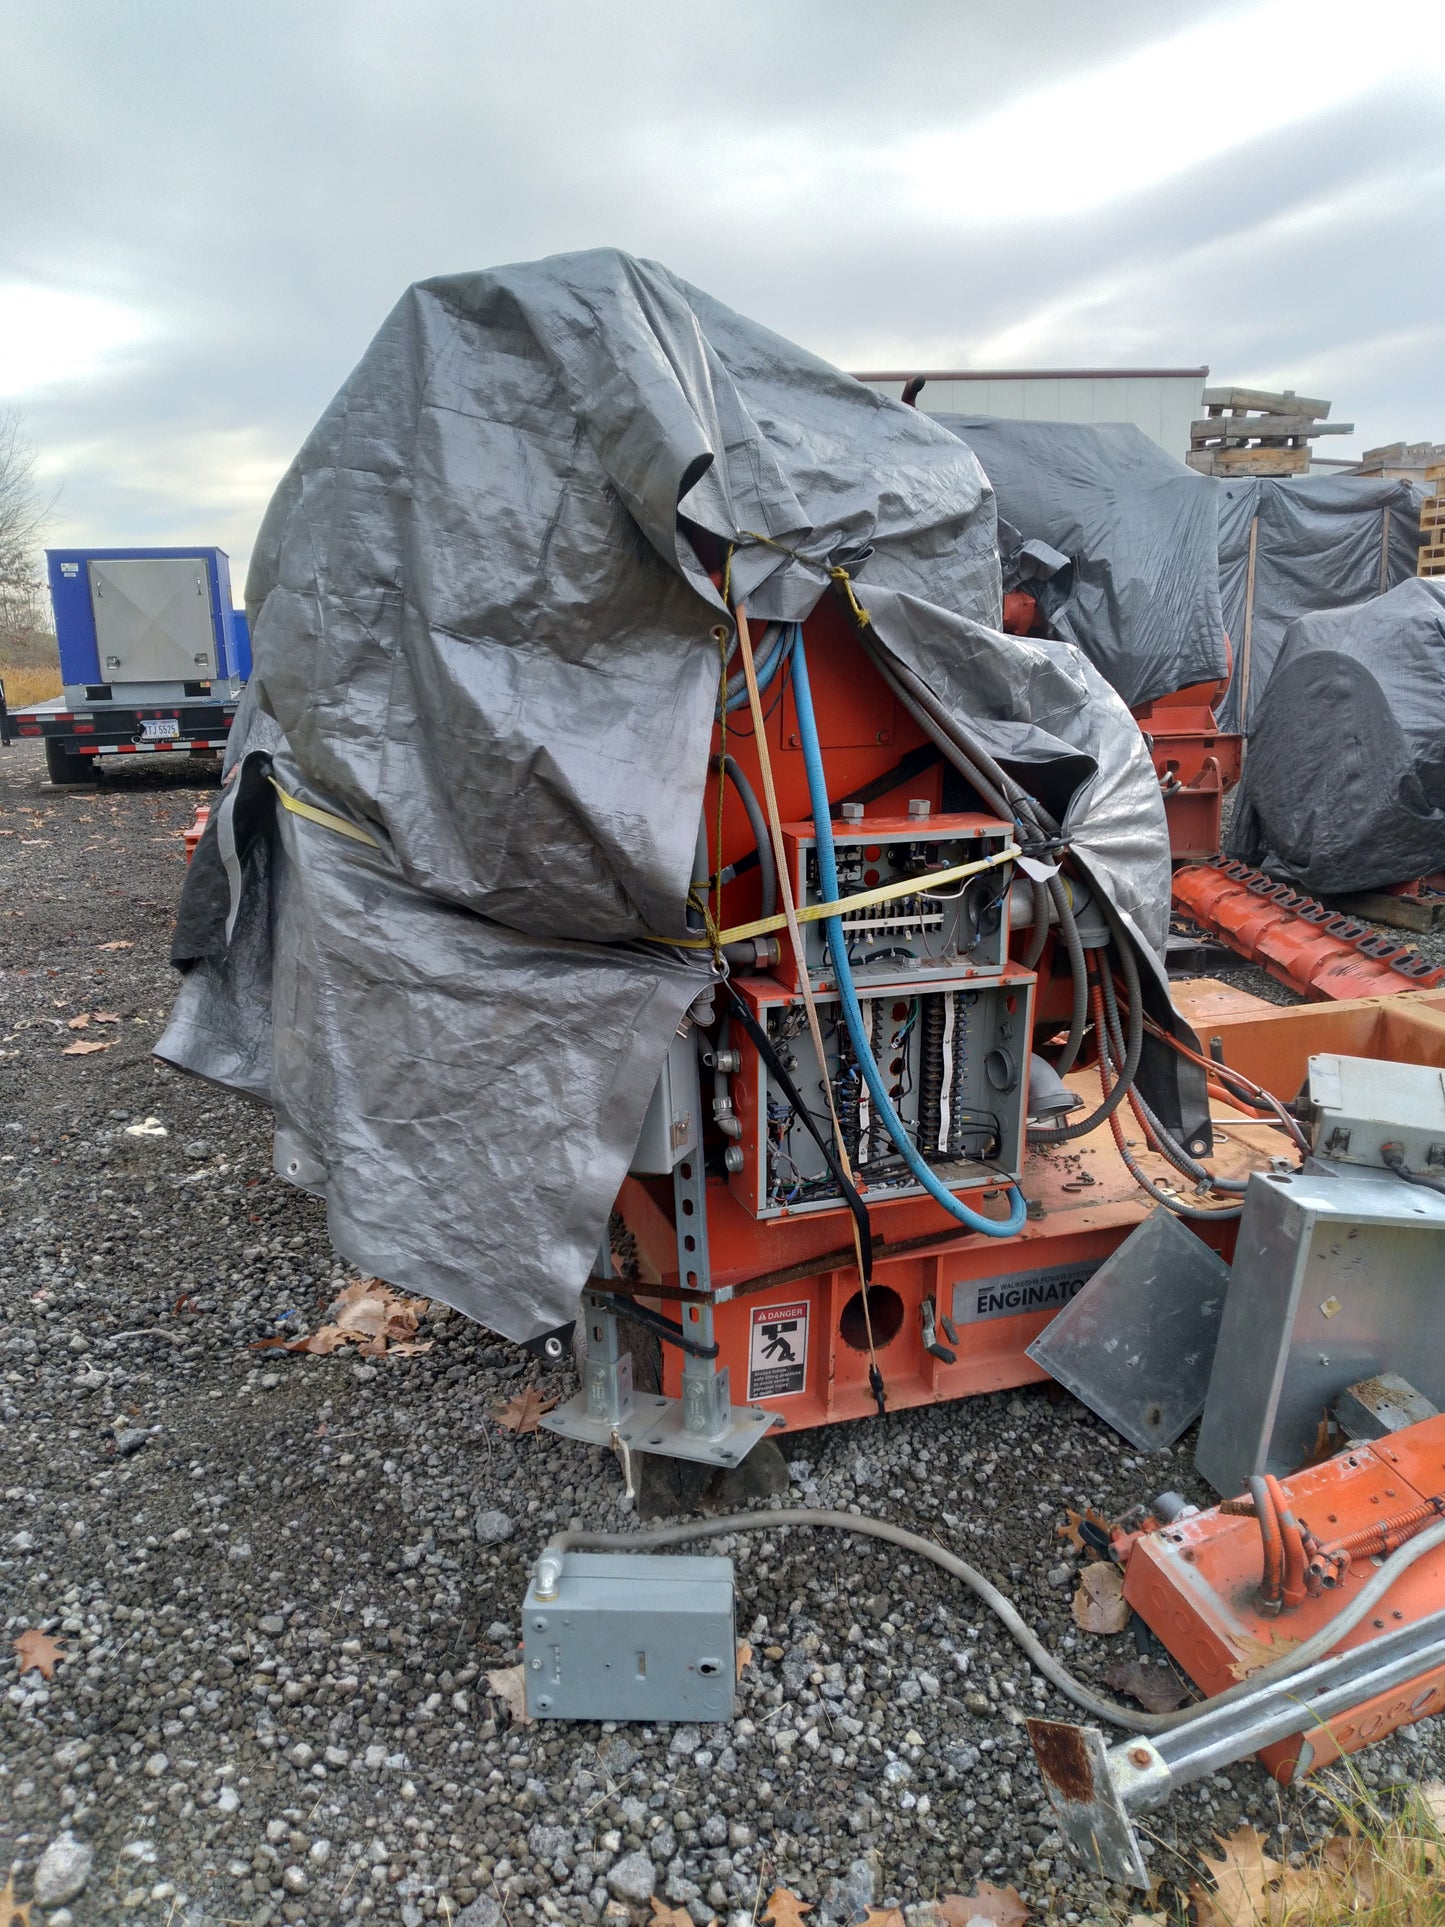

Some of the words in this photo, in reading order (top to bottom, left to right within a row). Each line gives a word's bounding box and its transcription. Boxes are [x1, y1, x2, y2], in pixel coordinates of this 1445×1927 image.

[158, 725, 176, 734] 5525
[1000, 1278, 1039, 1291] WAUKESHA
[1040, 1273, 1066, 1284] POWER
[977, 1278, 1089, 1313] ENGINATO
[768, 1308, 803, 1319] DANGER
